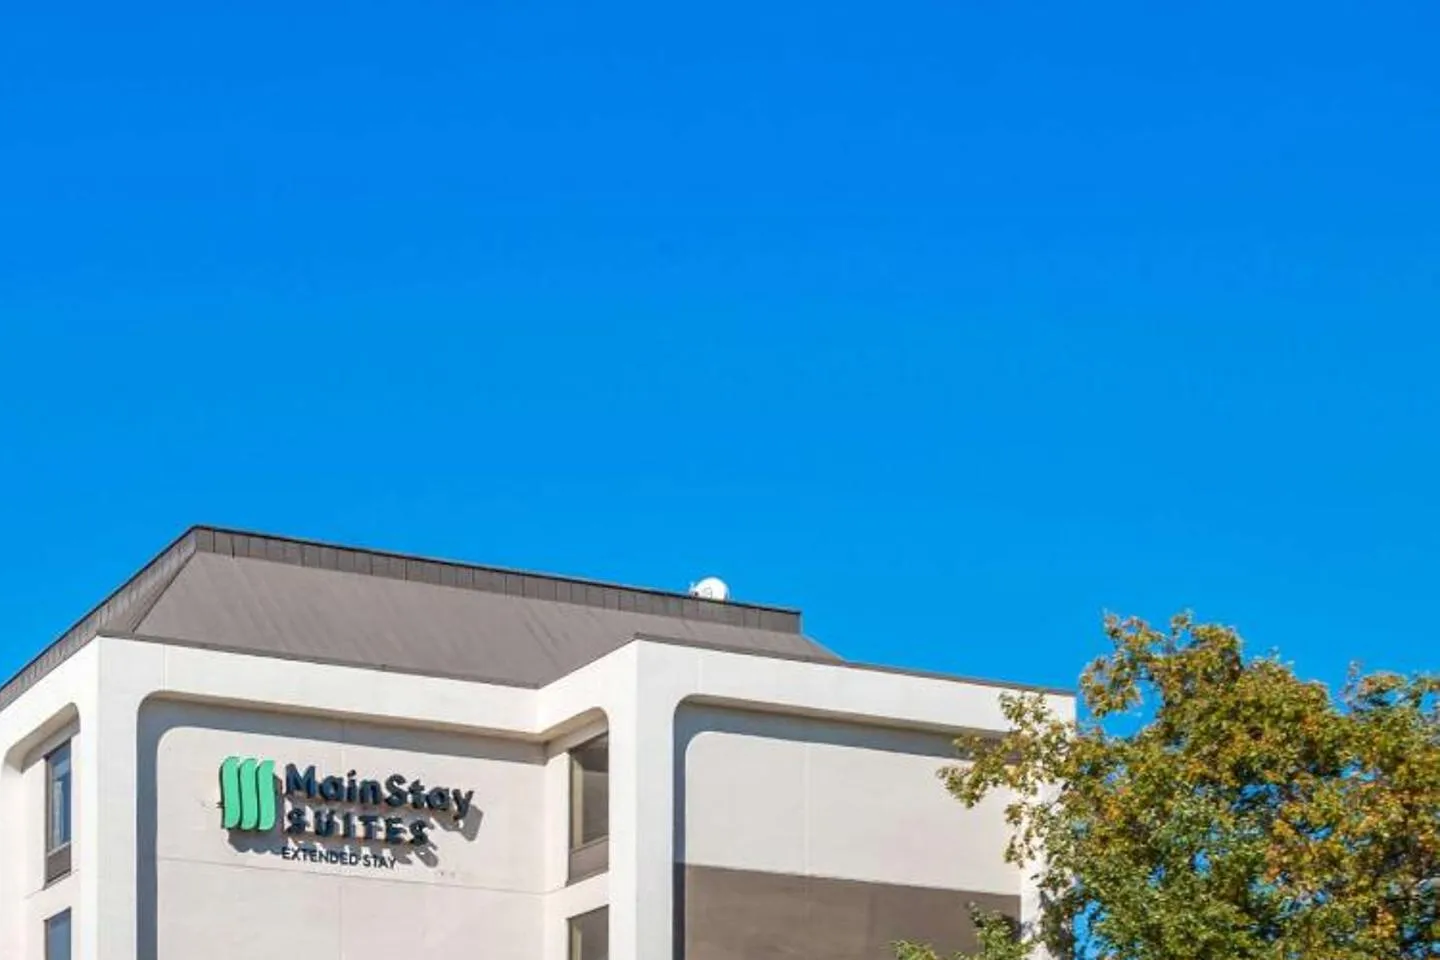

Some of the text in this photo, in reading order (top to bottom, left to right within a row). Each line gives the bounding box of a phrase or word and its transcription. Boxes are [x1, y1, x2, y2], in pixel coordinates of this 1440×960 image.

[285, 763, 474, 821] MainStay
[287, 807, 429, 846] SUITES
[281, 846, 396, 869] EXTENDED STAY
